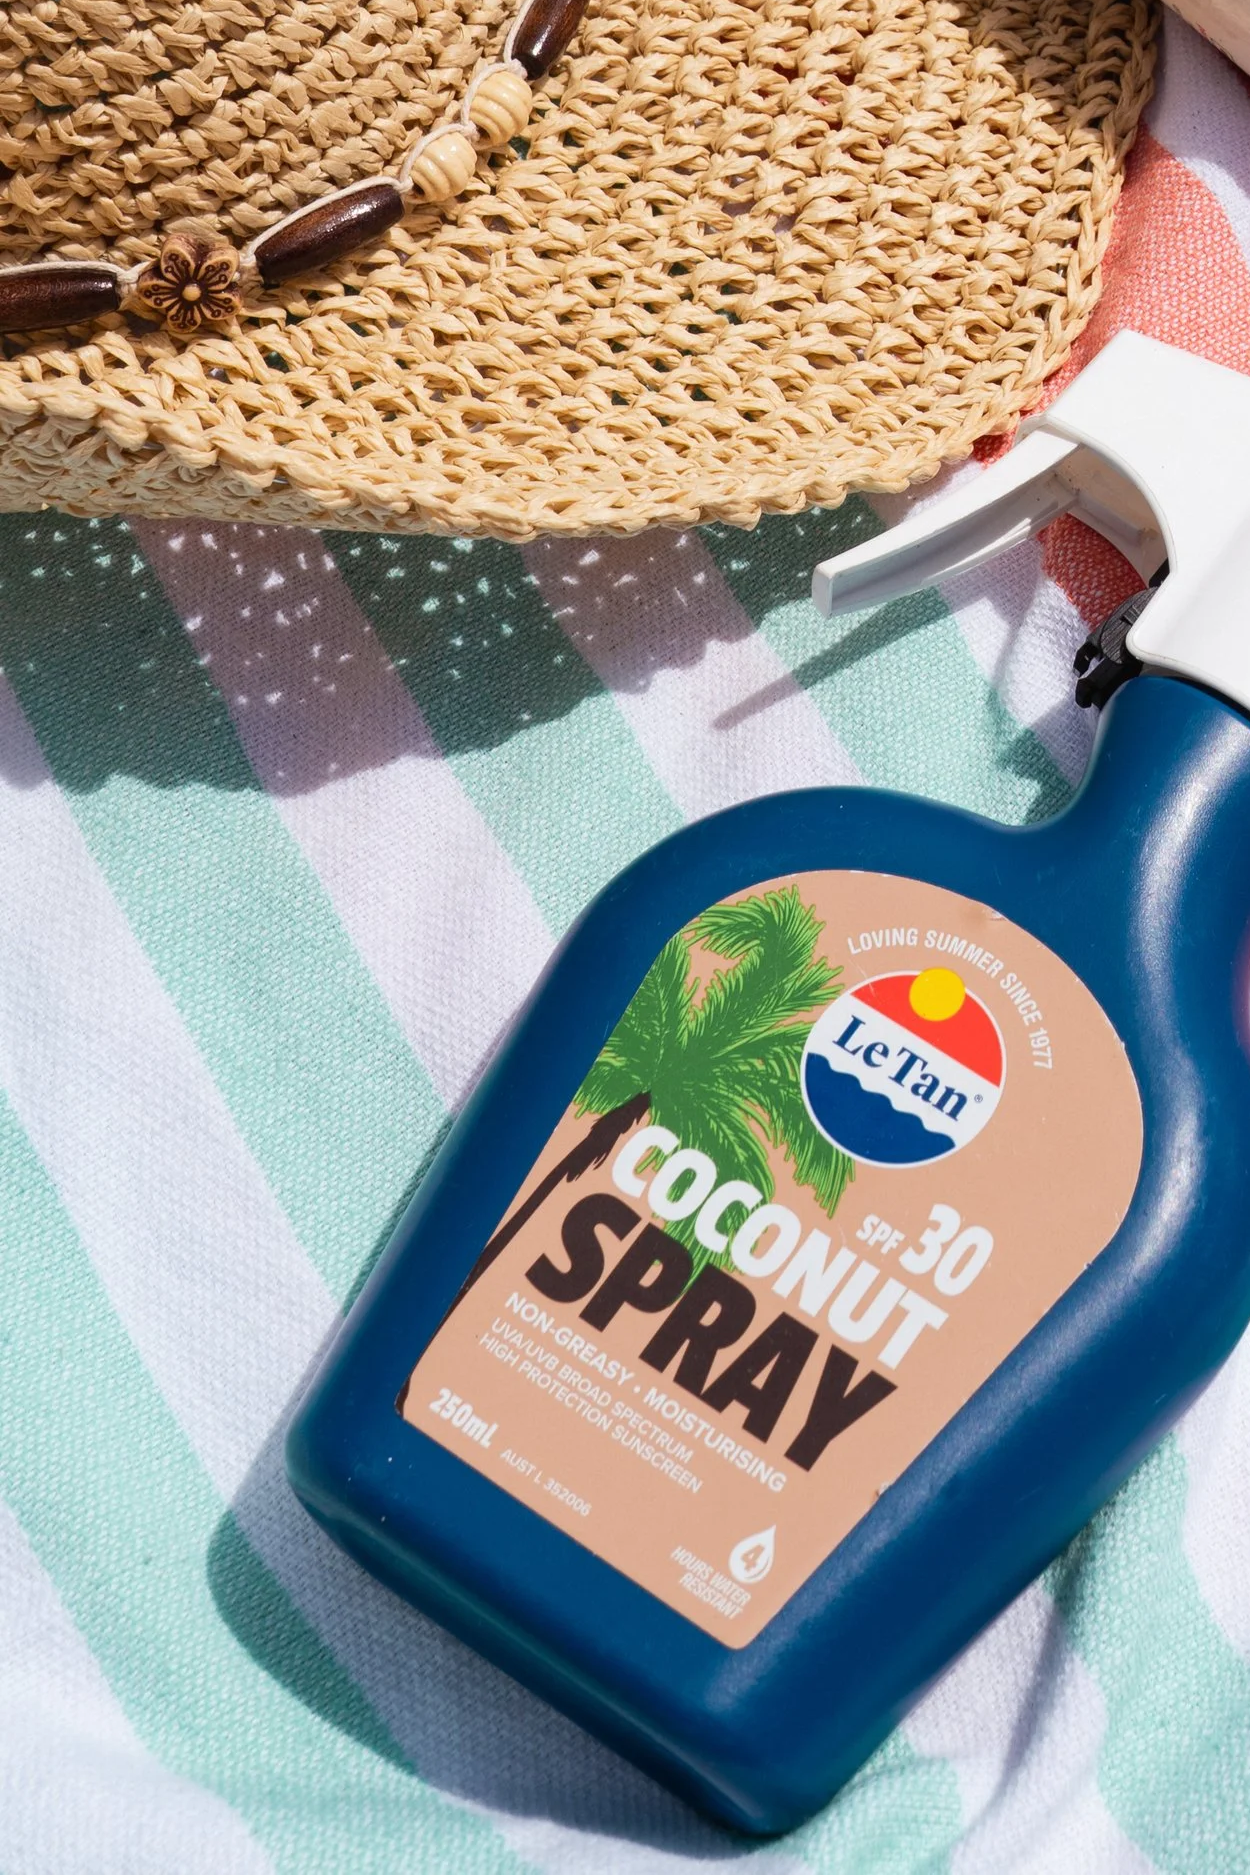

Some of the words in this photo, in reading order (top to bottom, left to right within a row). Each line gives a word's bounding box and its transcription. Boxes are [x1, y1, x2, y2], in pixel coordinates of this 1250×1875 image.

[847, 927, 918, 955] LOVING
[924, 929, 1005, 979] SUMMER
[1000, 972, 1043, 1026] SINCE
[1028, 1027, 1053, 1069] 1977
[611, 1124, 949, 1371] COCONUT
[856, 1213, 905, 1256] SPF
[899, 1203, 995, 1297] 30
[491, 1316, 559, 1370] UVA/UVB
[557, 1362, 611, 1407] BROAD
[610, 1401, 693, 1465] SPECTRUM
[525, 1192, 898, 1473] SPRAY
[429, 1387, 499, 1449] 250mL
[478, 1332, 519, 1368] HIGH
[516, 1358, 612, 1433] PROTECTION
[610, 1427, 704, 1495] SUNSCREEN
[505, 1291, 635, 1387] NON-GREASY
[643, 1386, 788, 1493] MOISTURISING
[500, 1448, 537, 1477] AUST
[670, 1545, 714, 1581] HOURS
[709, 1571, 752, 1606] WATER
[679, 1572, 743, 1620] RESISTANT
[741, 1543, 765, 1572] 4
